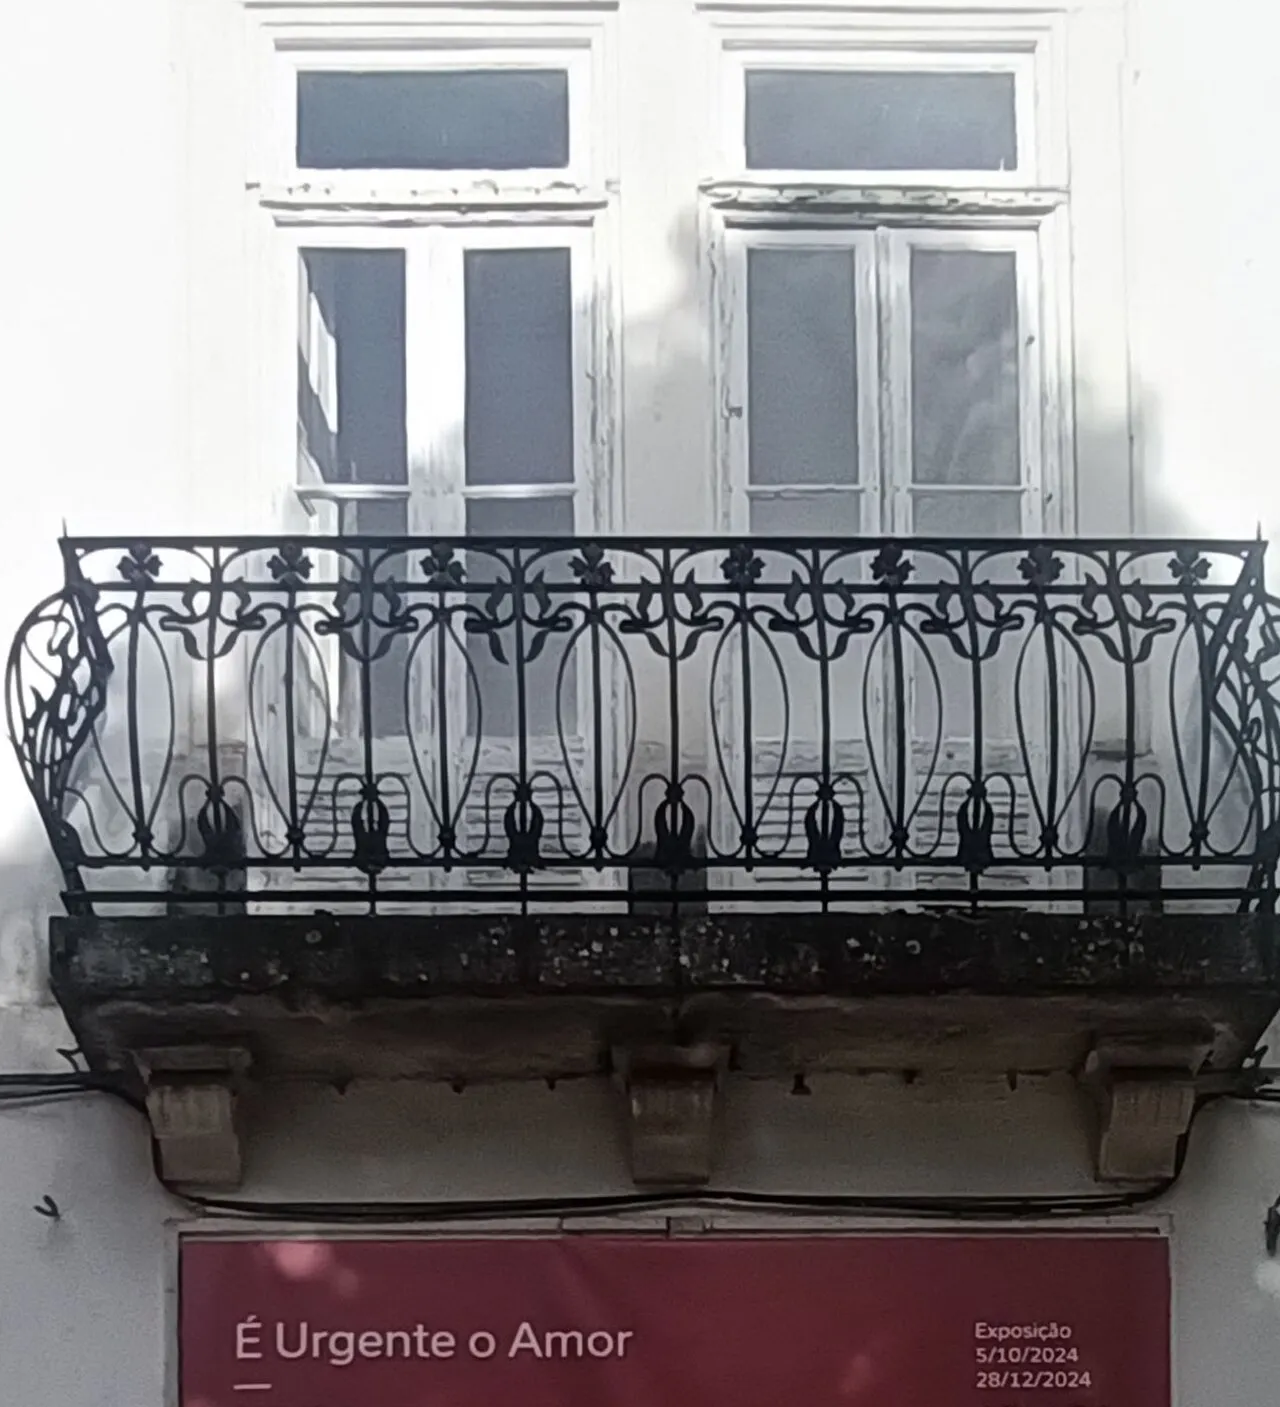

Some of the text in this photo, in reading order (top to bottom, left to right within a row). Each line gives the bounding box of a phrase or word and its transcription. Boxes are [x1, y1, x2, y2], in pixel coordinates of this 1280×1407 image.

[236, 1314, 634, 1366] É Urgente o Amor
[974, 1321, 1072, 1341] Exposição
[975, 1345, 1079, 1364] 5/10/2024
[976, 1370, 1092, 1389] 28/12/2024
